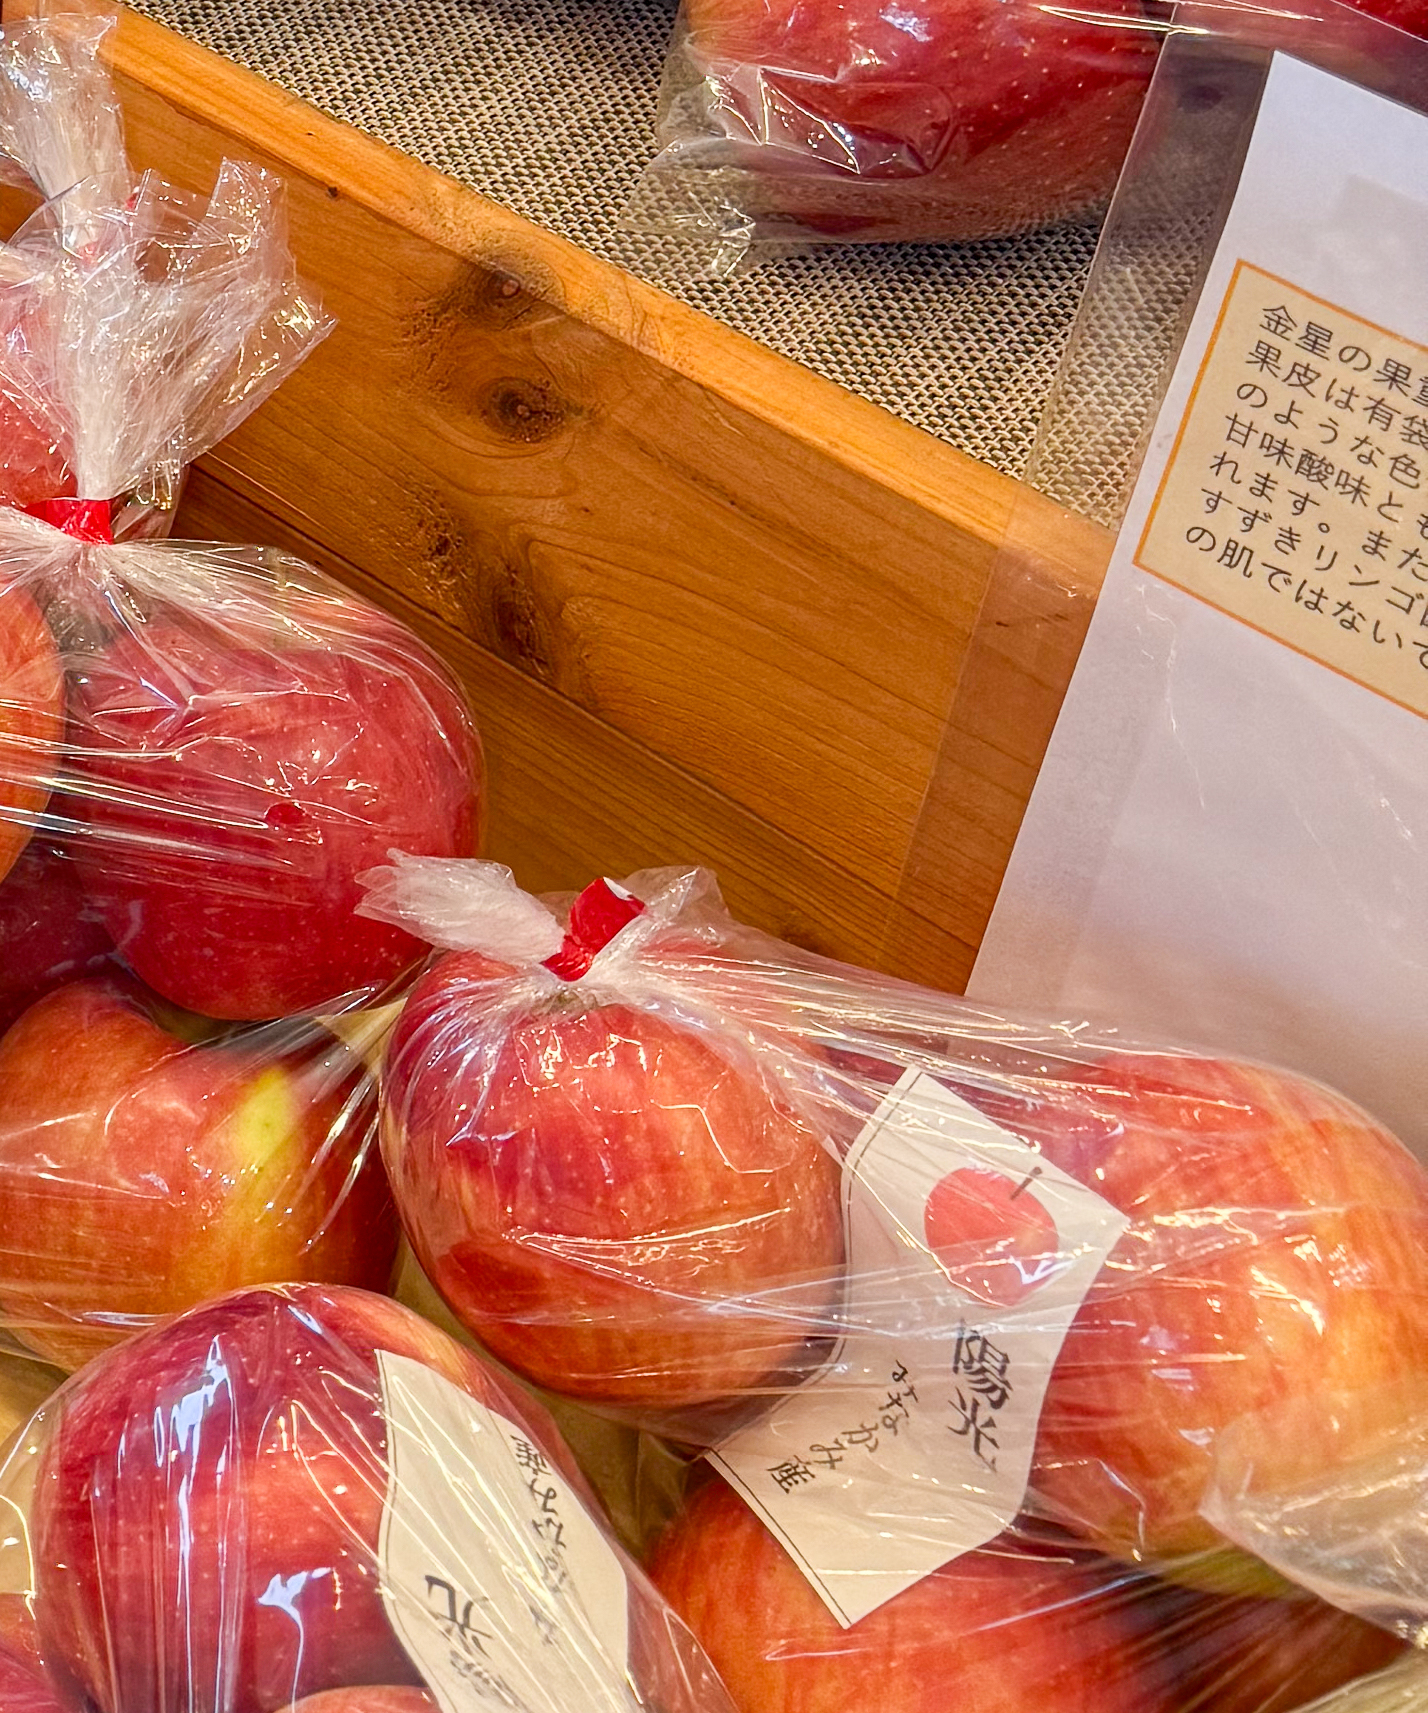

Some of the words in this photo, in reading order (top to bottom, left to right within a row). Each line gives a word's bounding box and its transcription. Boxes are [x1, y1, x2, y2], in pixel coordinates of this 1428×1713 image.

[1236, 383, 1421, 489] のような色
[1200, 488, 1428, 627] すずきリンゴ
[1209, 451, 1428, 582] れます。また
[767, 1360, 918, 1495] みなかみ産
[948, 1316, 1016, 1474] 陽光
